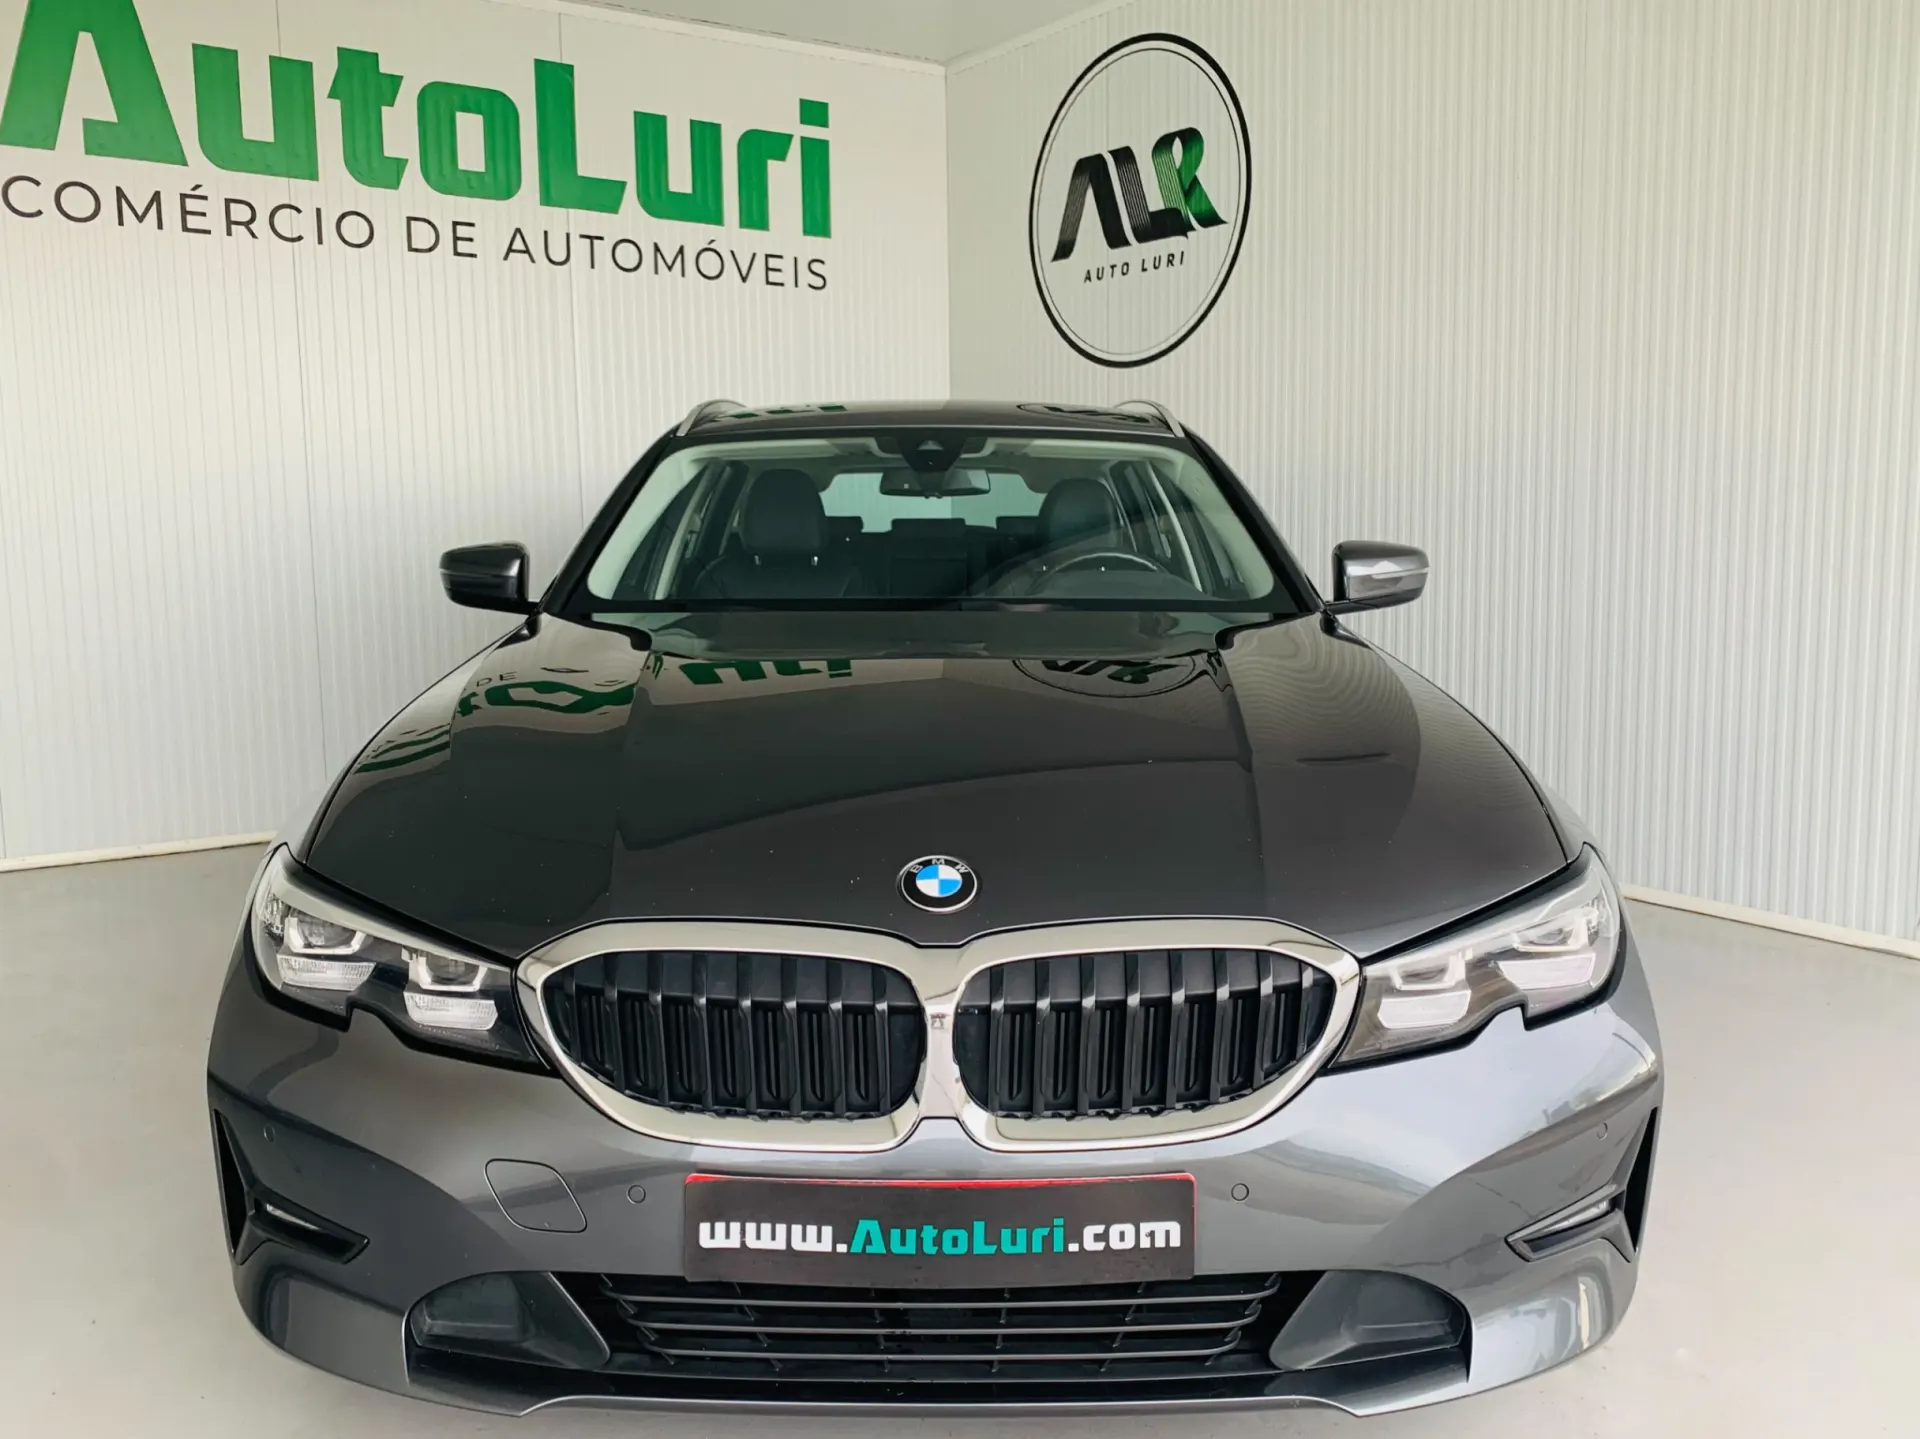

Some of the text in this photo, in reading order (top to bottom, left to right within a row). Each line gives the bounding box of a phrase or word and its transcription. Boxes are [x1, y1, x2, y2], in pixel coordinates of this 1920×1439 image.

[0, 0, 831, 239] AutoLuri
[1, 175, 828, 290] COMÉRCIO DE AUTOMÓVEIS
[1084, 251, 1185, 283] AUTO LURI
[909, 858, 969, 873] BMW
[699, 1217, 1182, 1255] www.AutoLuri.com
